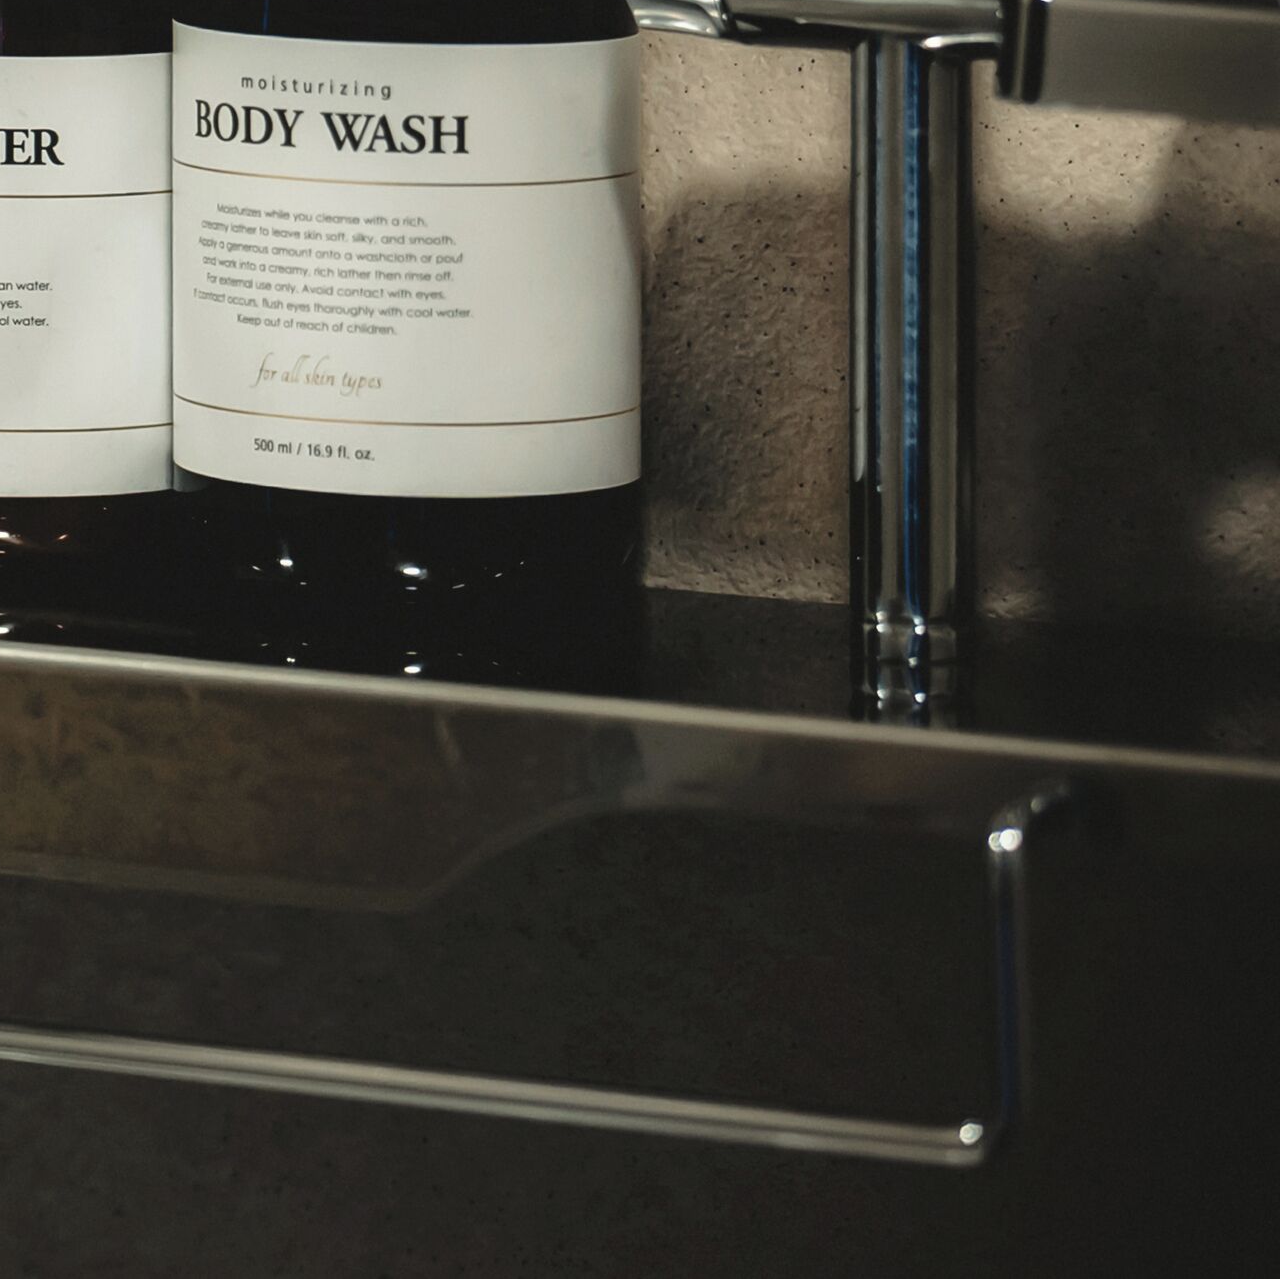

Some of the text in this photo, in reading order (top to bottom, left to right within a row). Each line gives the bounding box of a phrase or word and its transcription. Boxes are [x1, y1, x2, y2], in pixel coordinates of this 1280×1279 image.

[241, 75, 392, 100] moisturizing
[195, 100, 469, 154] BODY WASH
[364, 216, 387, 226] with
[381, 235, 405, 244] and
[345, 252, 352, 260] a
[16, 282, 52, 291] water.
[256, 281, 271, 290] use
[302, 284, 333, 296] Avoid
[337, 288, 384, 298] contact
[388, 290, 412, 298] with
[314, 303, 374, 318] thoroughly
[378, 307, 402, 316] with
[406, 308, 432, 318] cool
[12, 317, 49, 326] water.
[283, 319, 293, 328] of
[332, 322, 343, 332] of
[340, 371, 382, 396] types
[254, 439, 375, 461] 500 ml / 16.9 fl. oz.
